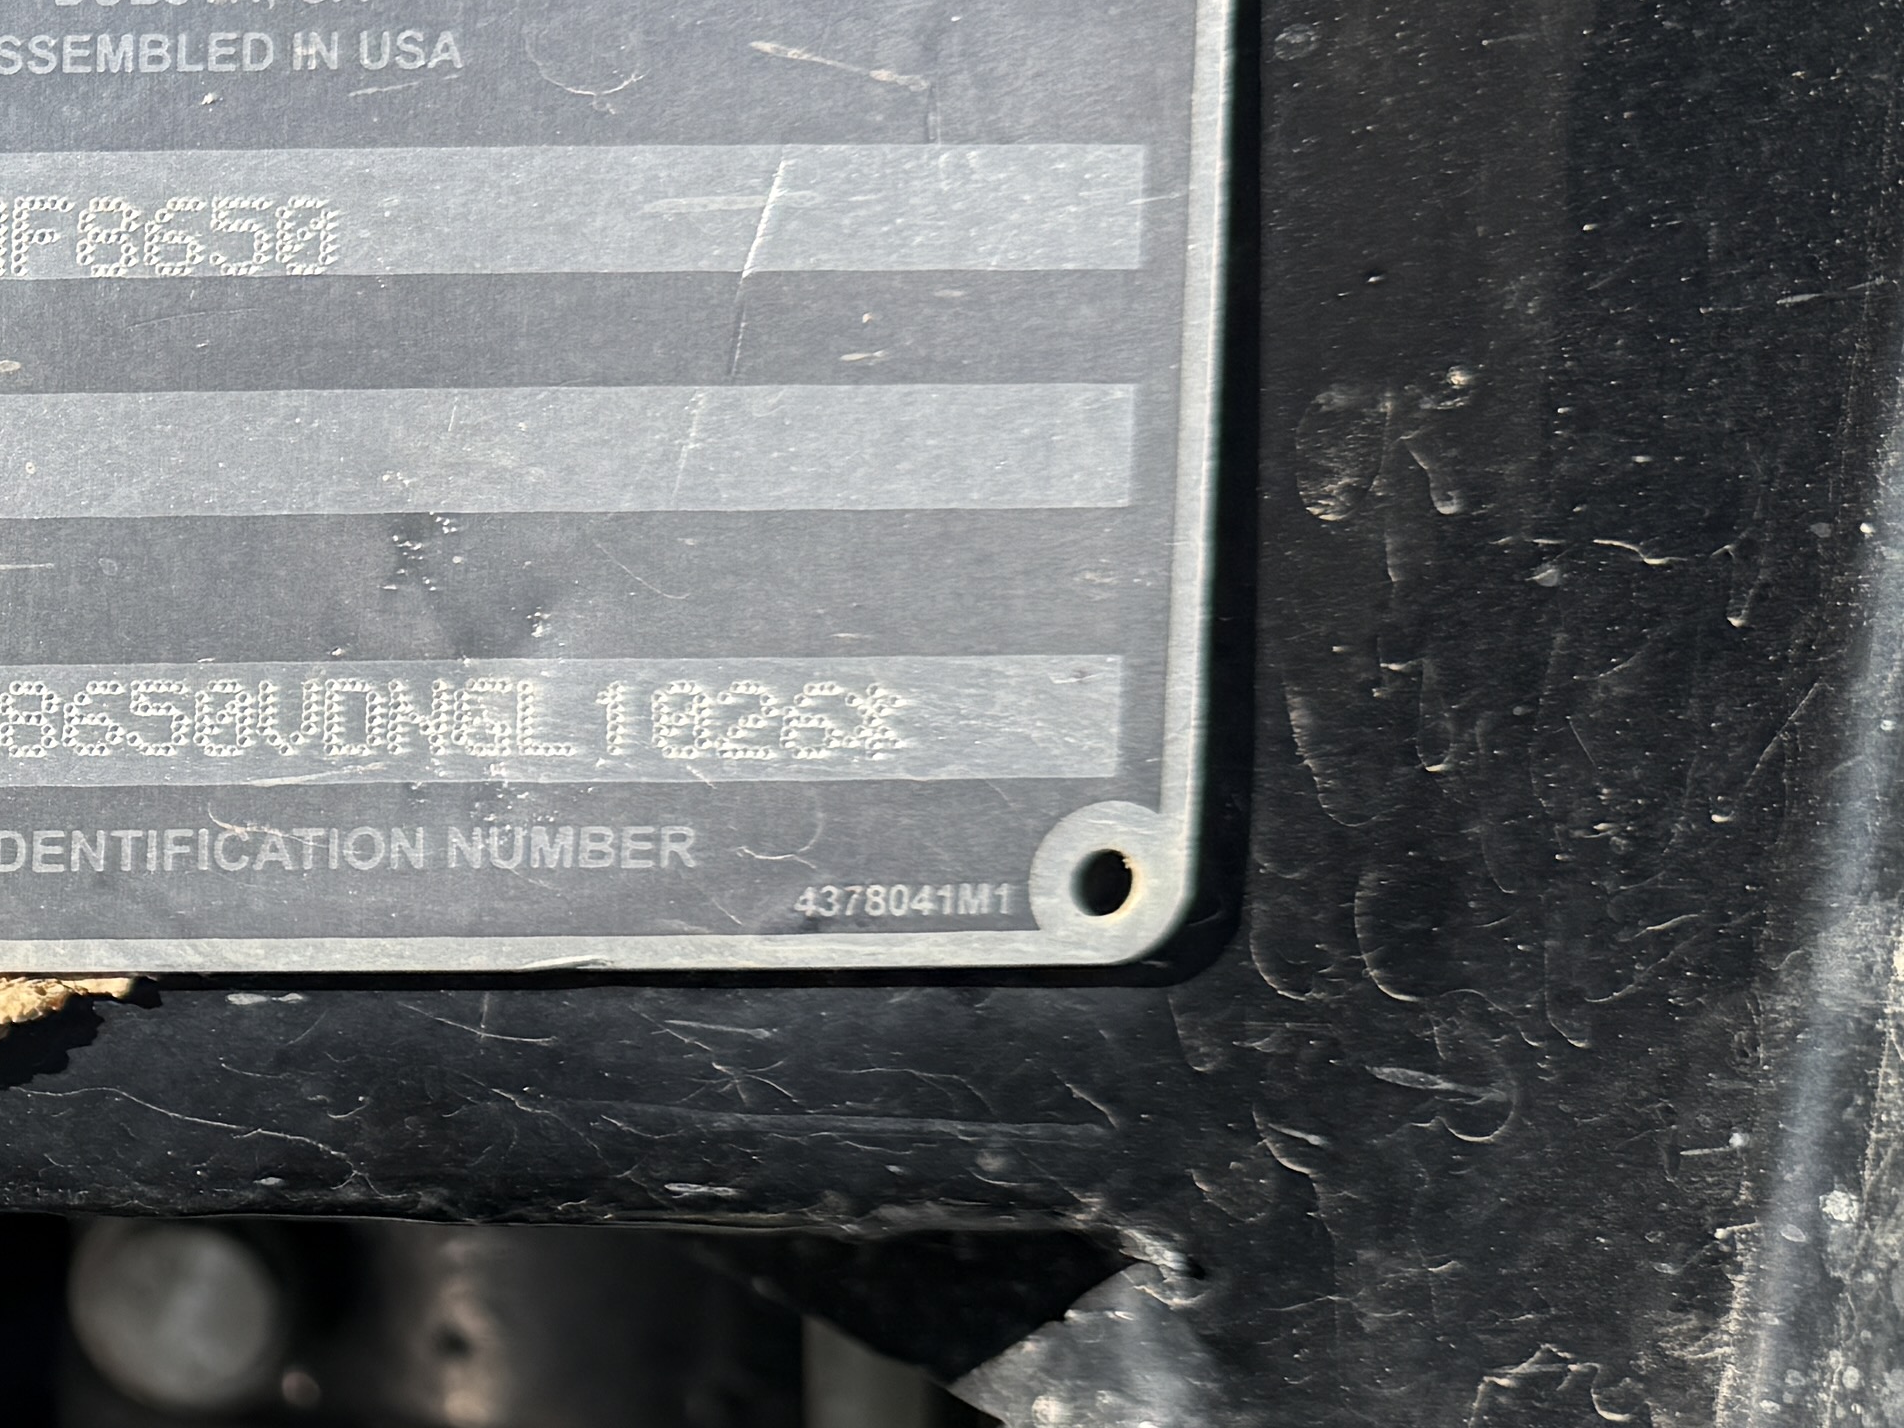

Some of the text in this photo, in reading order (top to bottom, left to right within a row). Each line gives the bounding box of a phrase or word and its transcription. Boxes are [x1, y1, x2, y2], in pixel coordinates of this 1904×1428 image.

[291, 31, 342, 72] IN
[358, 29, 466, 72] USA
[445, 824, 697, 872] NUMBER
[793, 883, 1013, 921] 4378041M1
